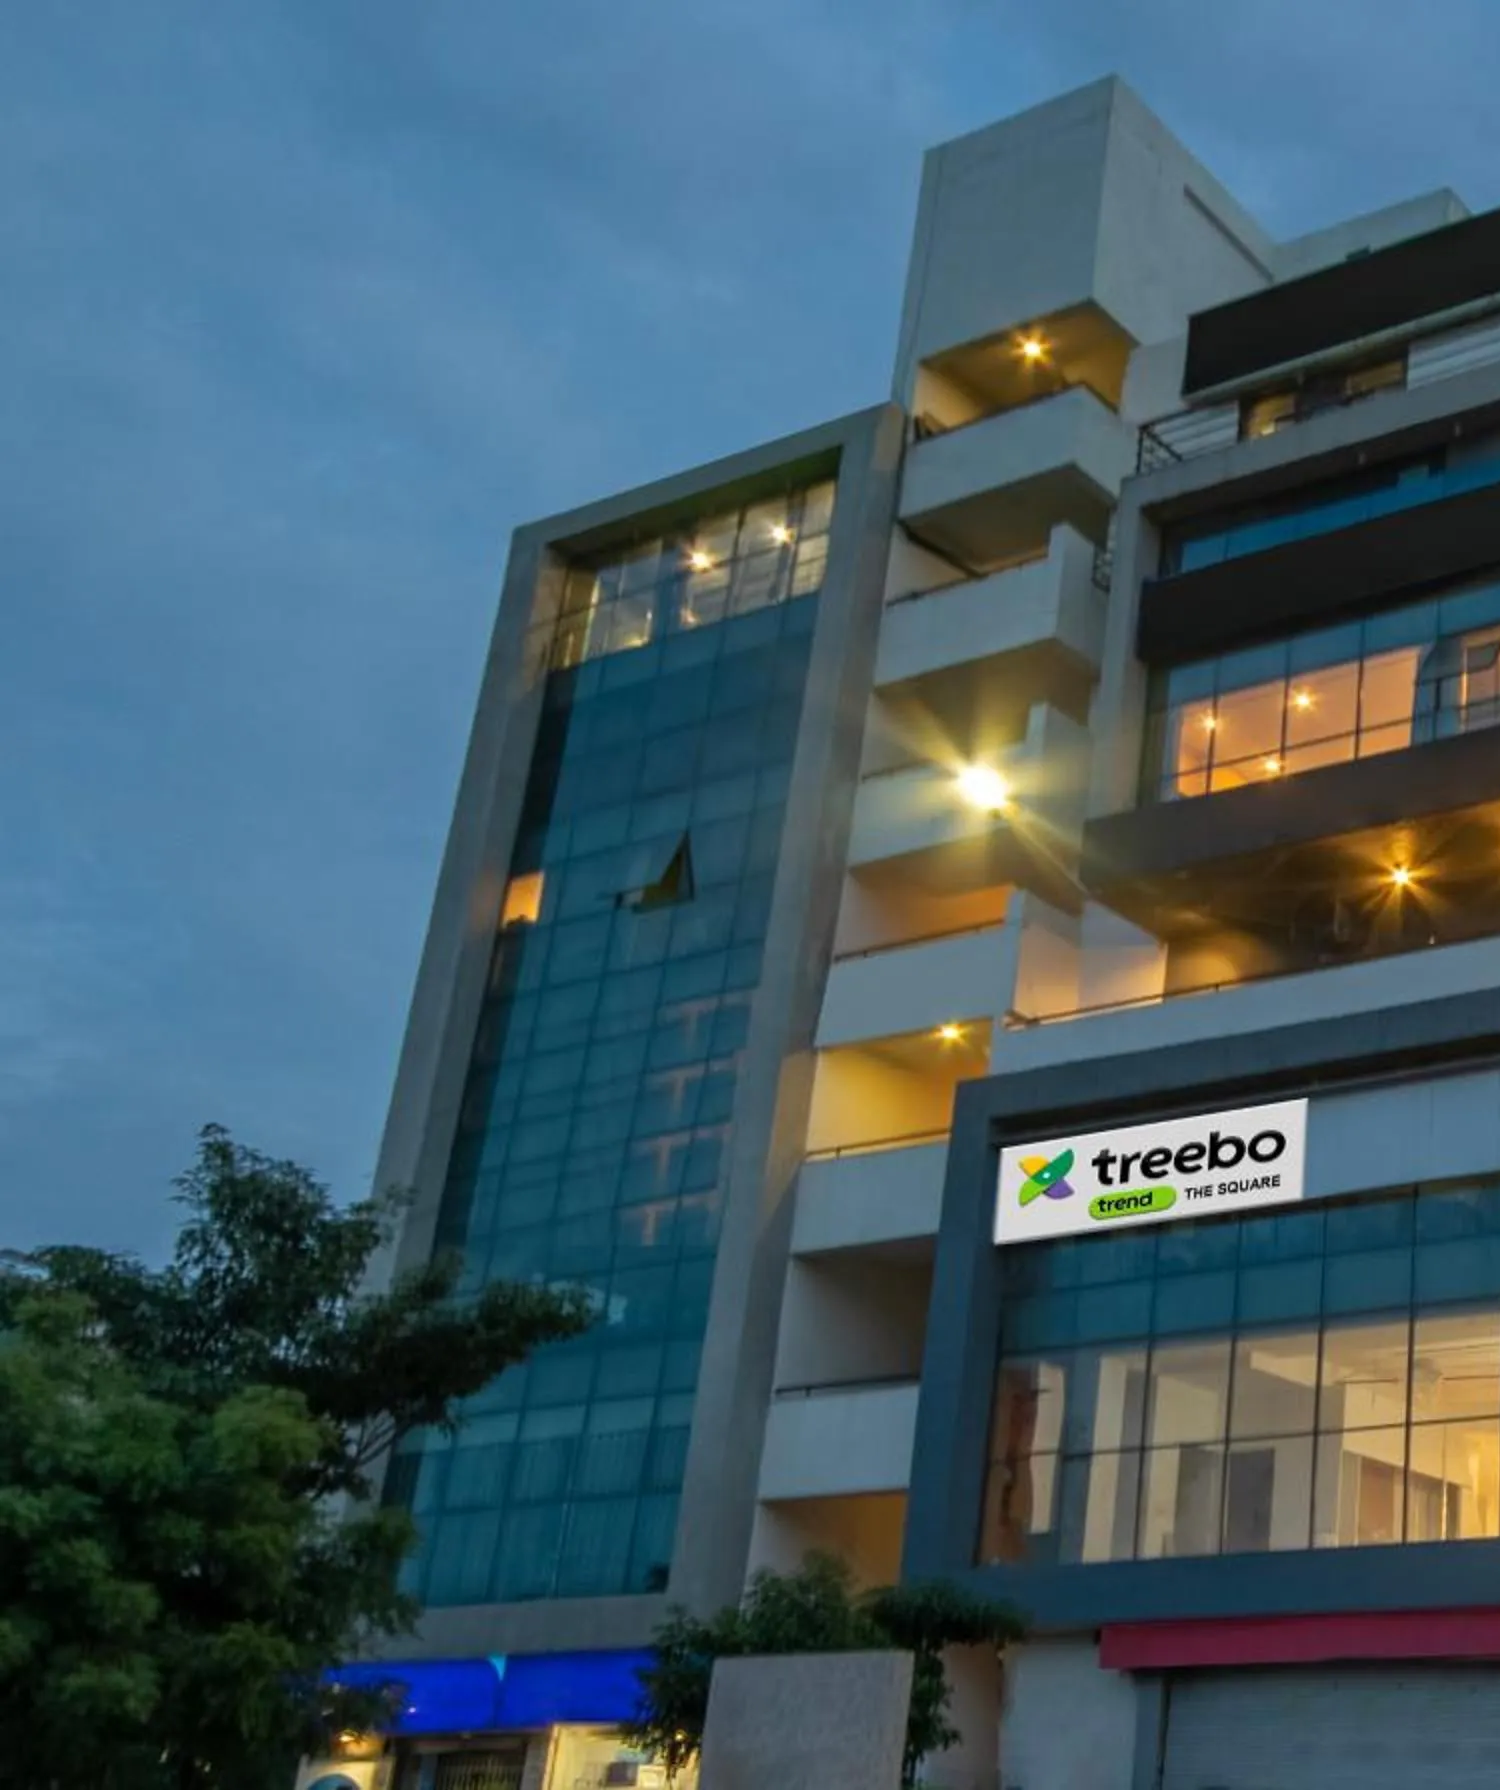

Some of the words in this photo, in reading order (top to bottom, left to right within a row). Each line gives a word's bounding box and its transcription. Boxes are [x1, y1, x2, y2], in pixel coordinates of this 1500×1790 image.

[1091, 1129, 1288, 1186] treebo
[1184, 1184, 1213, 1201] THE
[1217, 1174, 1281, 1195] SQUARE
[1097, 1191, 1154, 1214] trend
